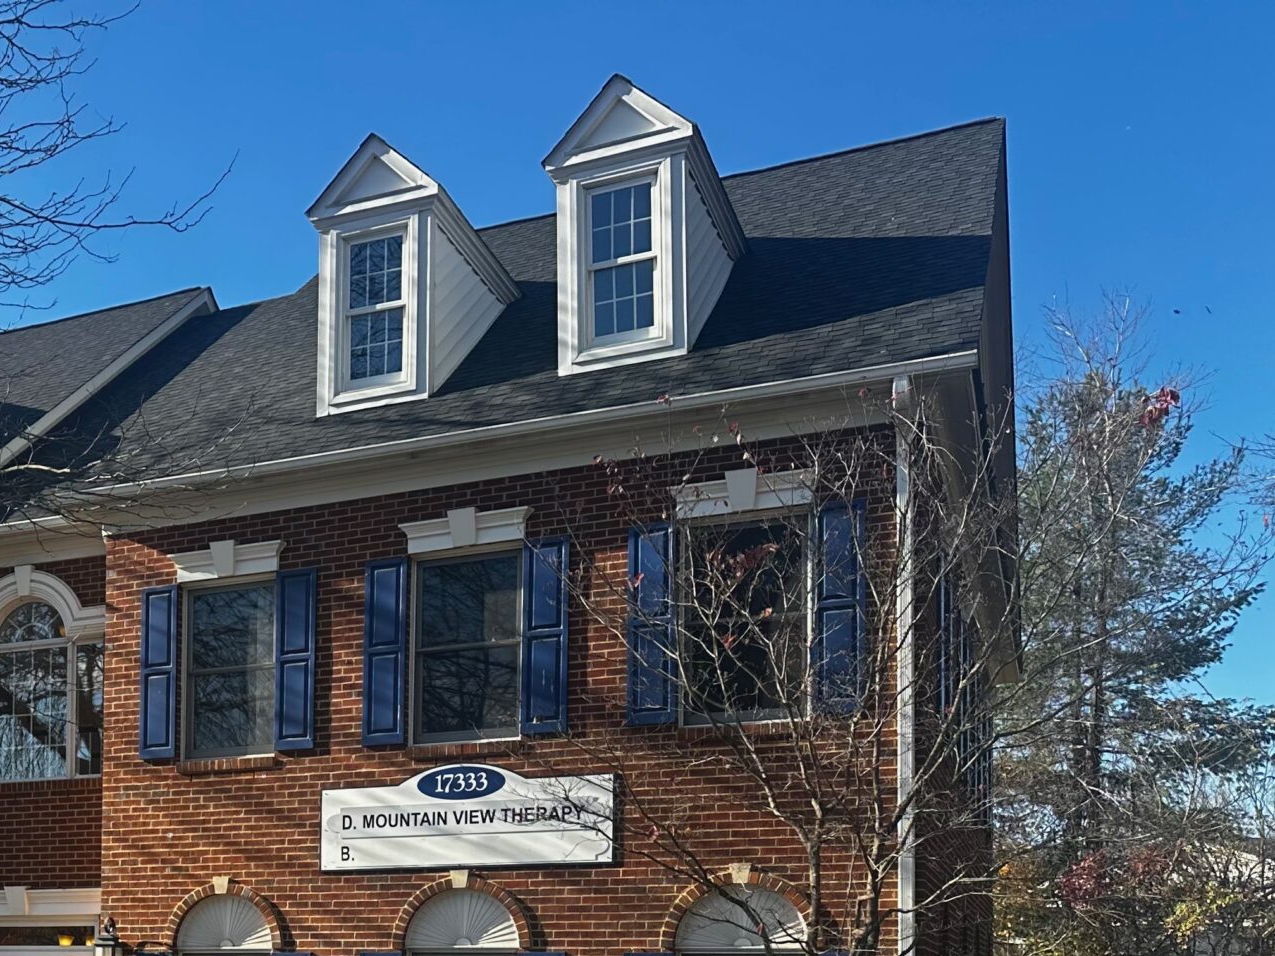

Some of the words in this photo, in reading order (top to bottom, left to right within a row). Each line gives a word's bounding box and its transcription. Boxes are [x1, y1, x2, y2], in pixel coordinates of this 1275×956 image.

[434, 771, 488, 793] 17333
[342, 814, 357, 830] D.
[362, 811, 448, 829] MOUNTAIN
[452, 808, 496, 825] VIEW
[501, 805, 585, 823] THERAPY
[340, 846, 355, 861] B.
